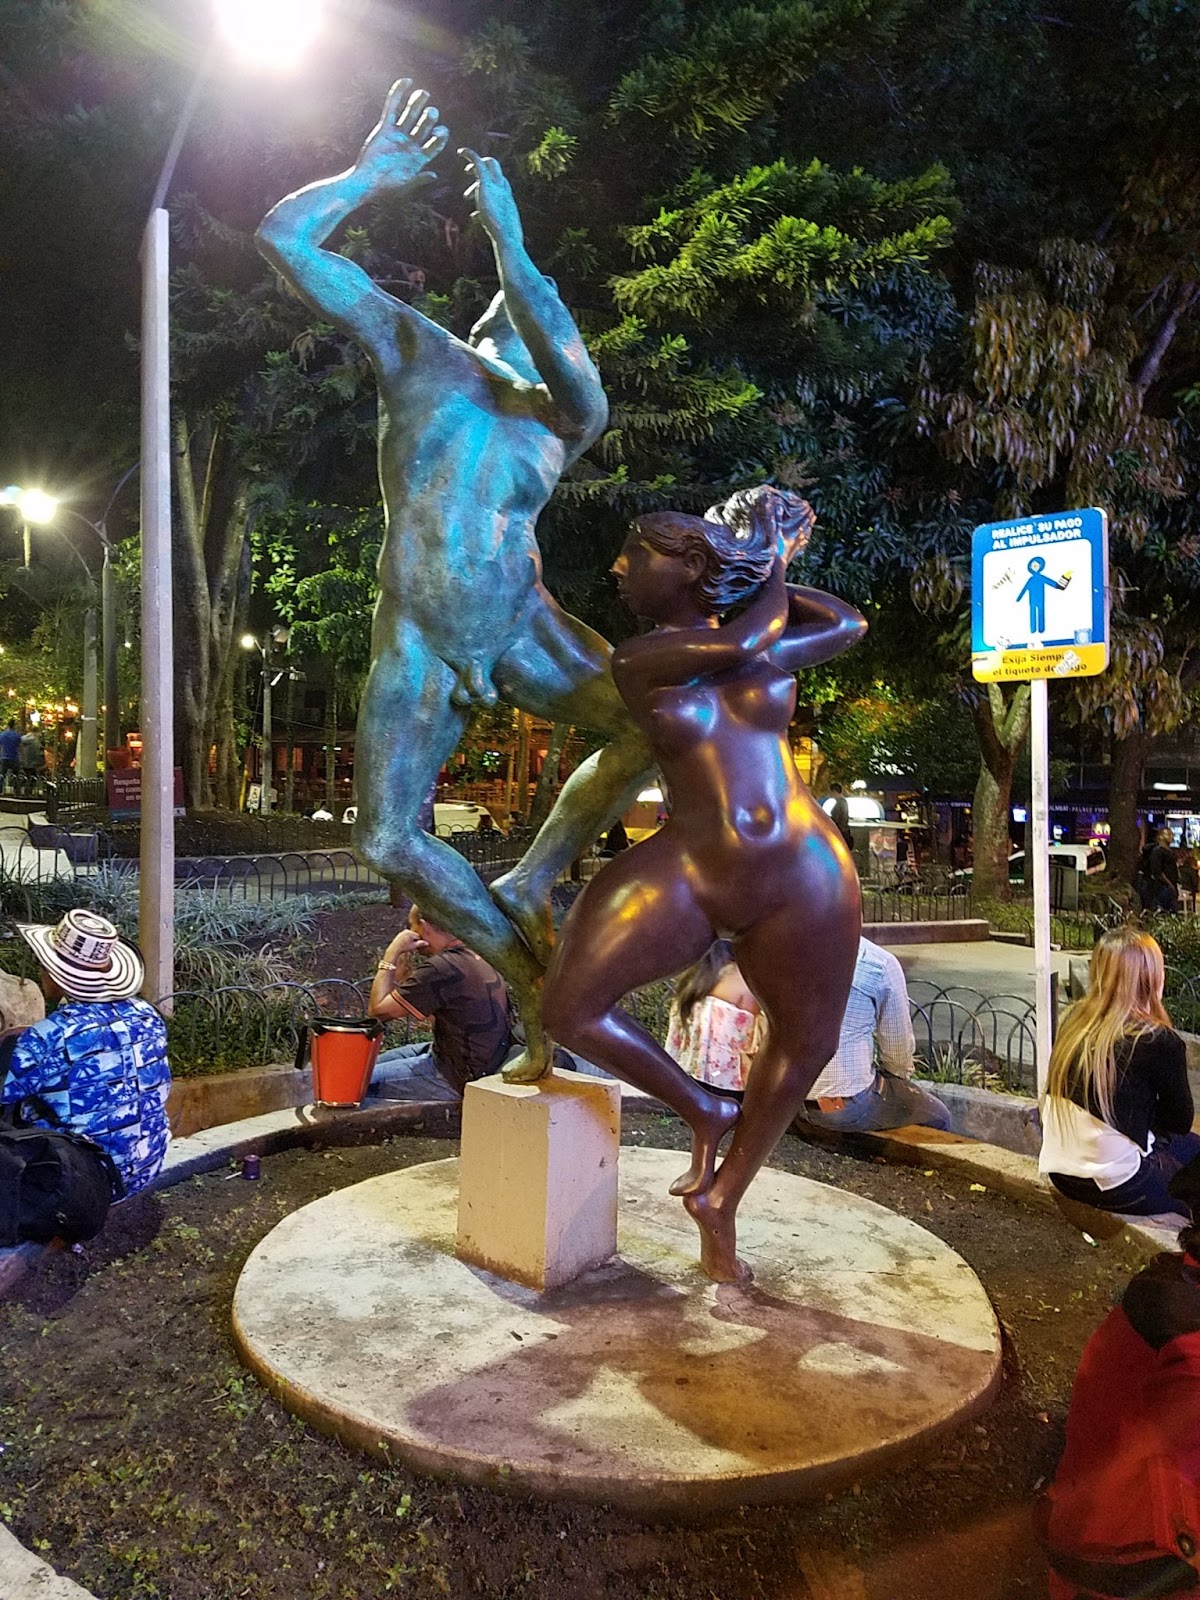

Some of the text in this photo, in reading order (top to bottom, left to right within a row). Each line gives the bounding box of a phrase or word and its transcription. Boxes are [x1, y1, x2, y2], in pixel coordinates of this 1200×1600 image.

[992, 518, 1082, 539] REALICE SU PAGO
[992, 528, 1082, 550] AL IMPULSADOR
[1002, 652, 1065, 665] Exija Siemp
[993, 668, 1002, 676] el
[1005, 664, 1041, 676] tiquete
